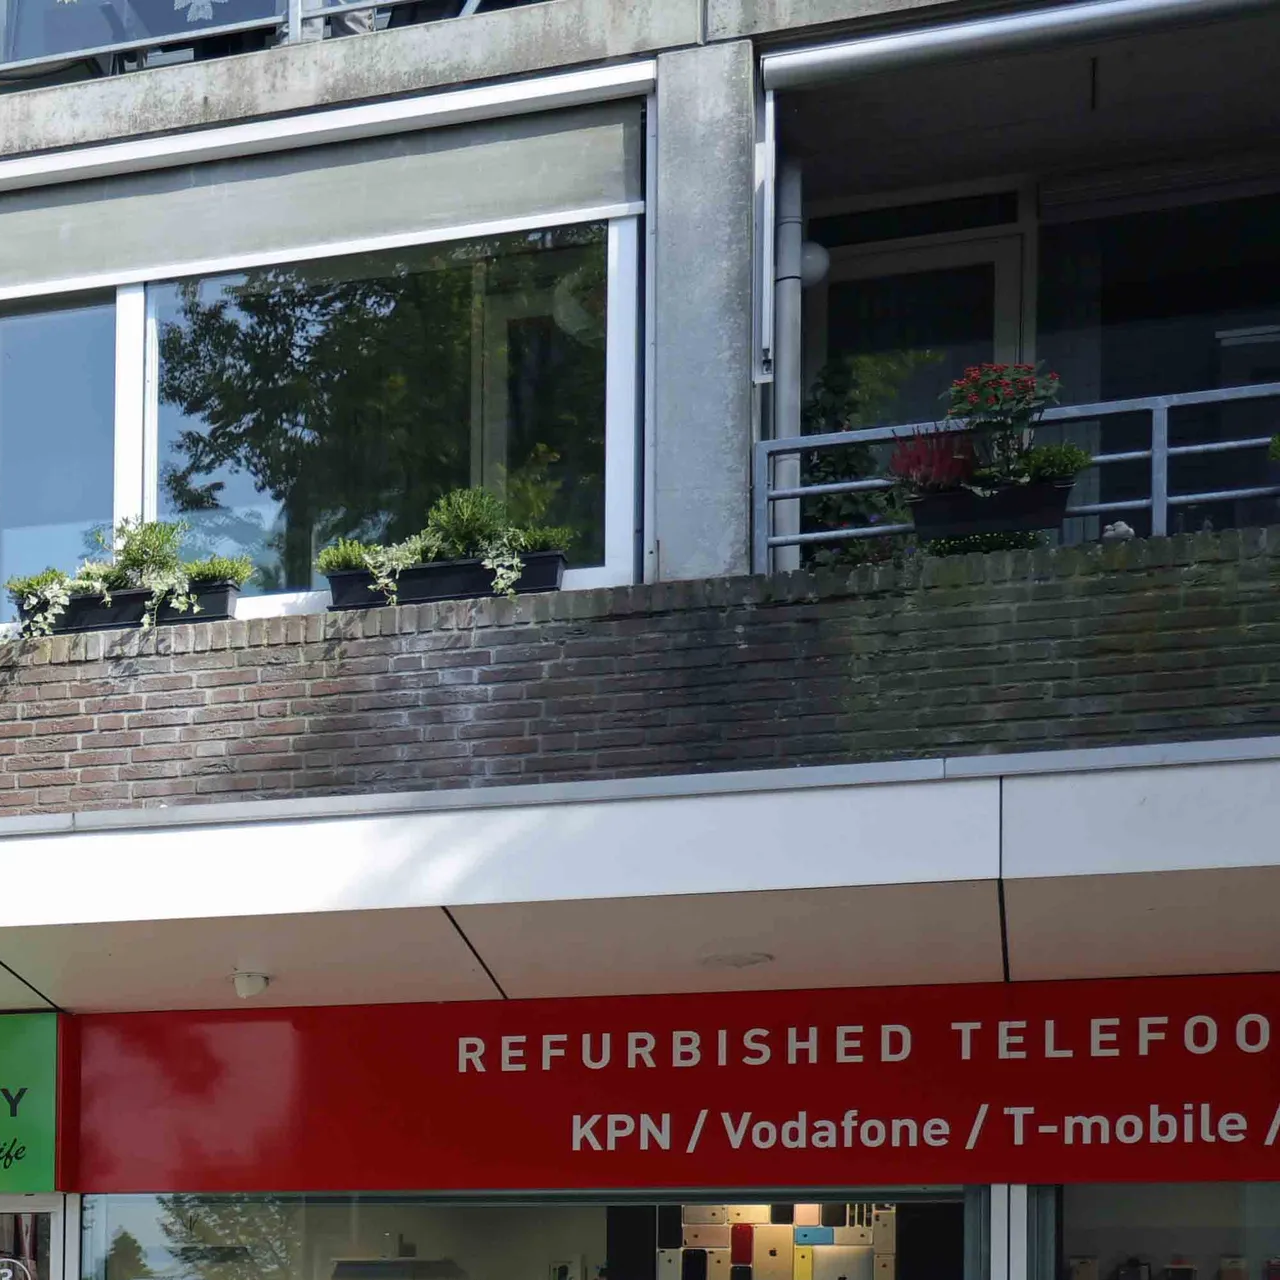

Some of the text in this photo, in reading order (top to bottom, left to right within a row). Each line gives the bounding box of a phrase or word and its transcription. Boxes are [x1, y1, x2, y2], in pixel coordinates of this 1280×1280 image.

[458, 1013, 1270, 1073] REFURBISHED TELEFOO
[571, 1112, 671, 1152] KPN
[686, 1108, 709, 1154] /
[720, 1109, 950, 1150] Vodafone
[964, 1103, 989, 1150] /
[1003, 1102, 1248, 1146] T-mobile
